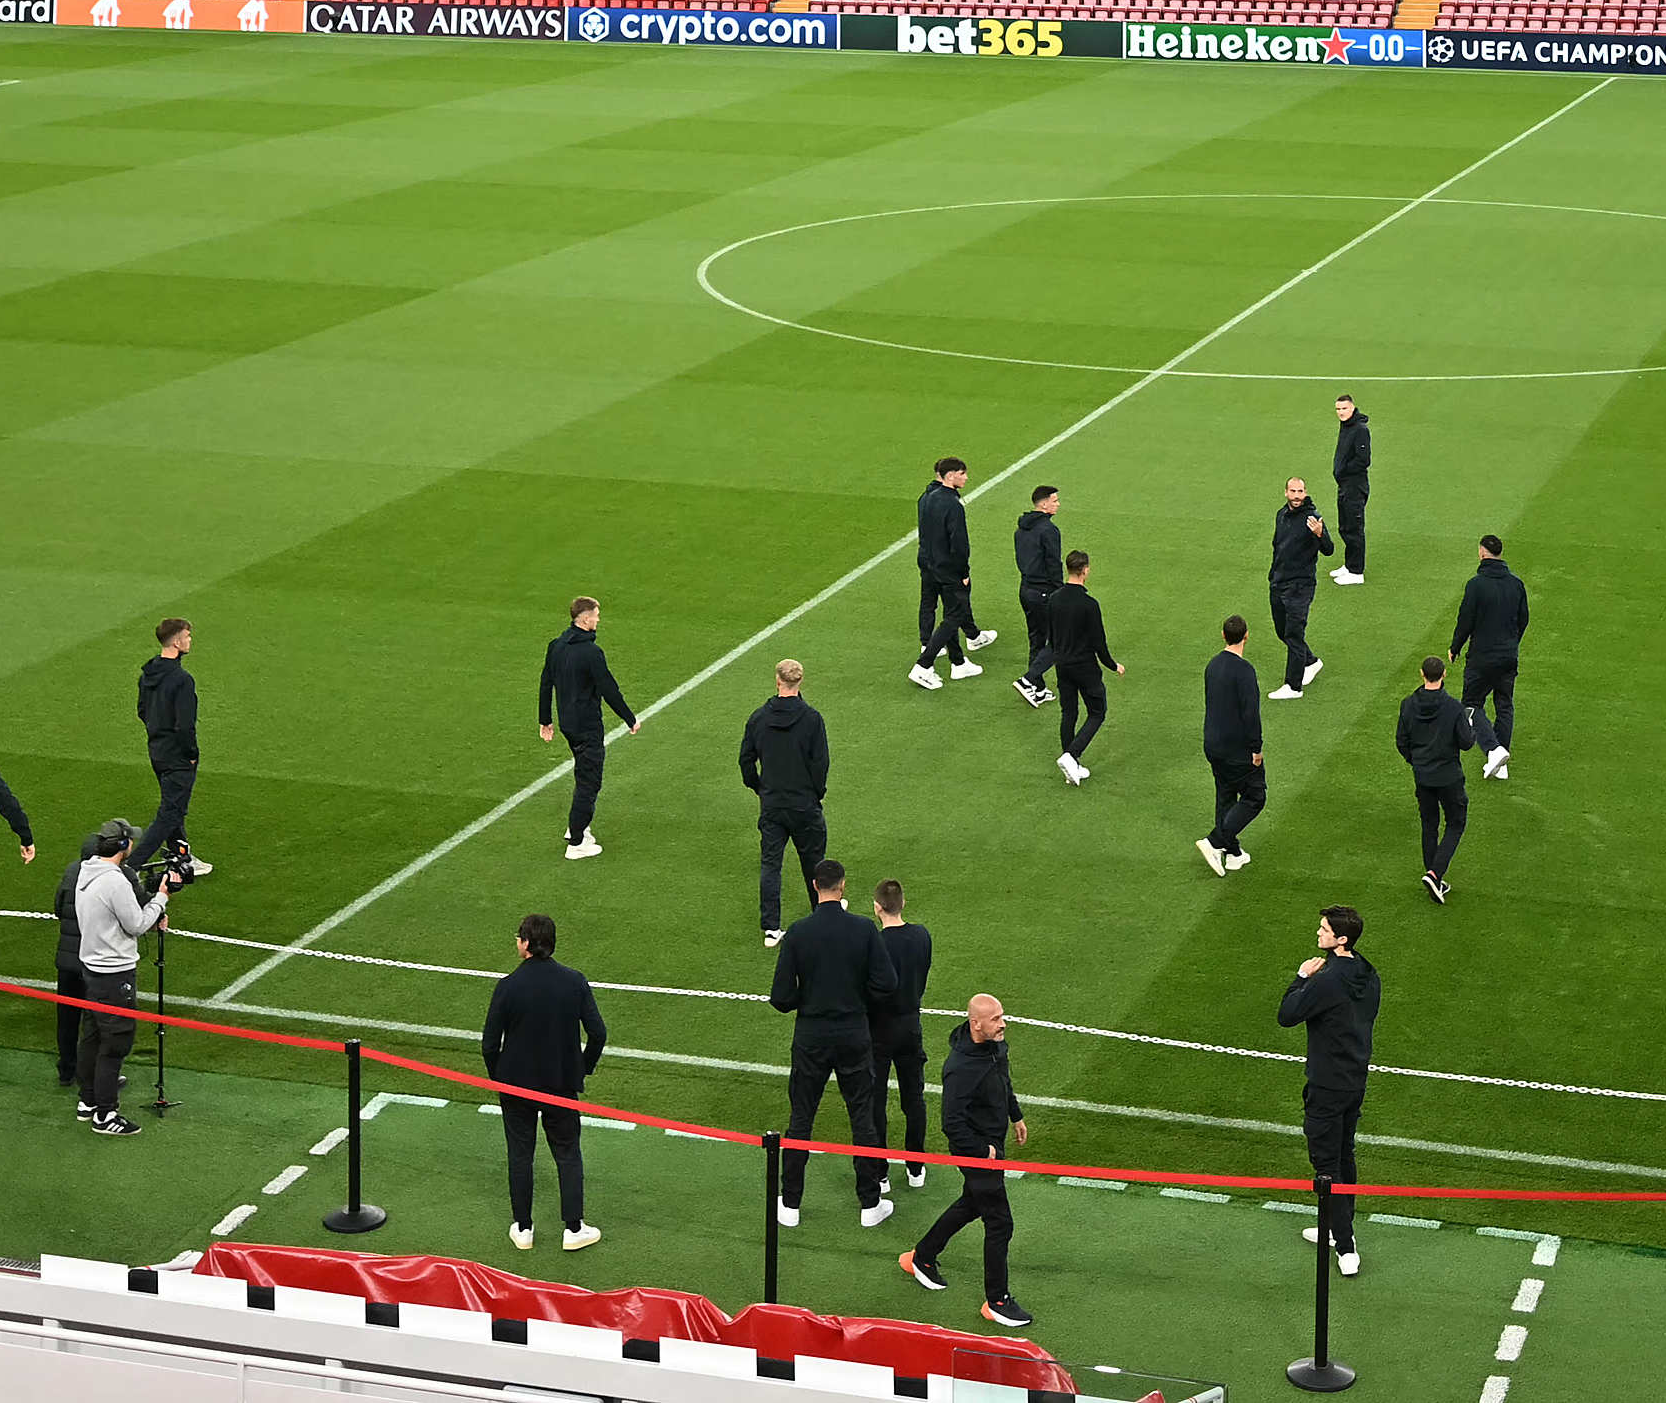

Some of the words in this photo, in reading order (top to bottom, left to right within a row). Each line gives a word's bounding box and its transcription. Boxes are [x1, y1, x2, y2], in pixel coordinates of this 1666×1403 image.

[310, 4, 415, 35] QATAR
[427, 8, 562, 38] AIRWAYS
[620, 11, 826, 44] crypto.com
[897, 16, 1063, 56] bet365
[1128, 24, 1321, 62] Heineken
[1461, 38, 1527, 63] UEFA
